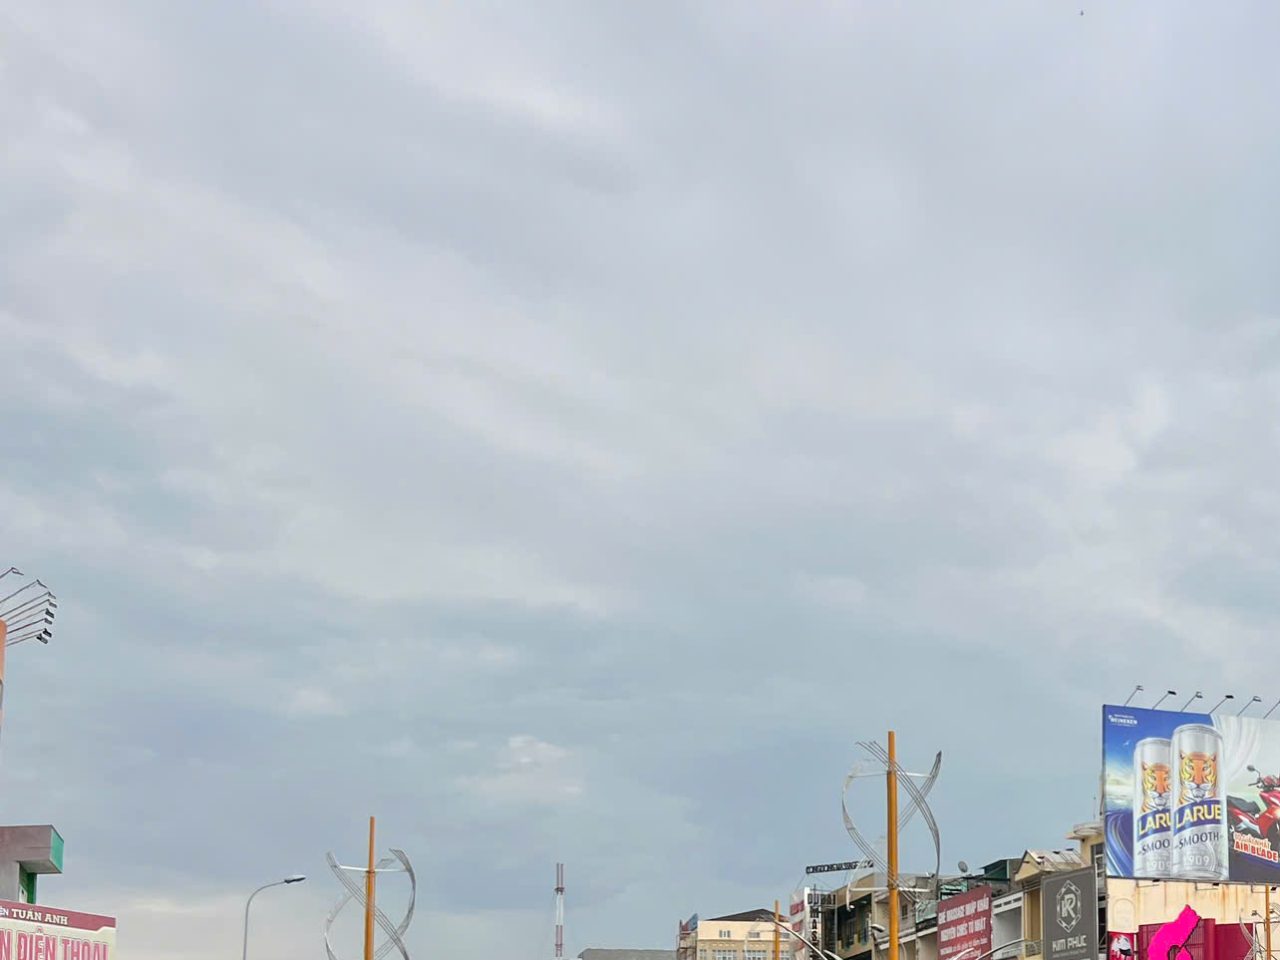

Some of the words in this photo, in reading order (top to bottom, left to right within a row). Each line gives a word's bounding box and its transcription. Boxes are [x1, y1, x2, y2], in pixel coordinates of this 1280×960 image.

[1175, 802, 1222, 829] LARUE
[1179, 832, 1219, 850] SMOOTH
[1235, 841, 1249, 853] AIR
[1251, 845, 1278, 862] BLADE
[11, 907, 42, 922] TUẤN
[44, 914, 70, 925] ANH
[1052, 939, 1066, 953] KIM
